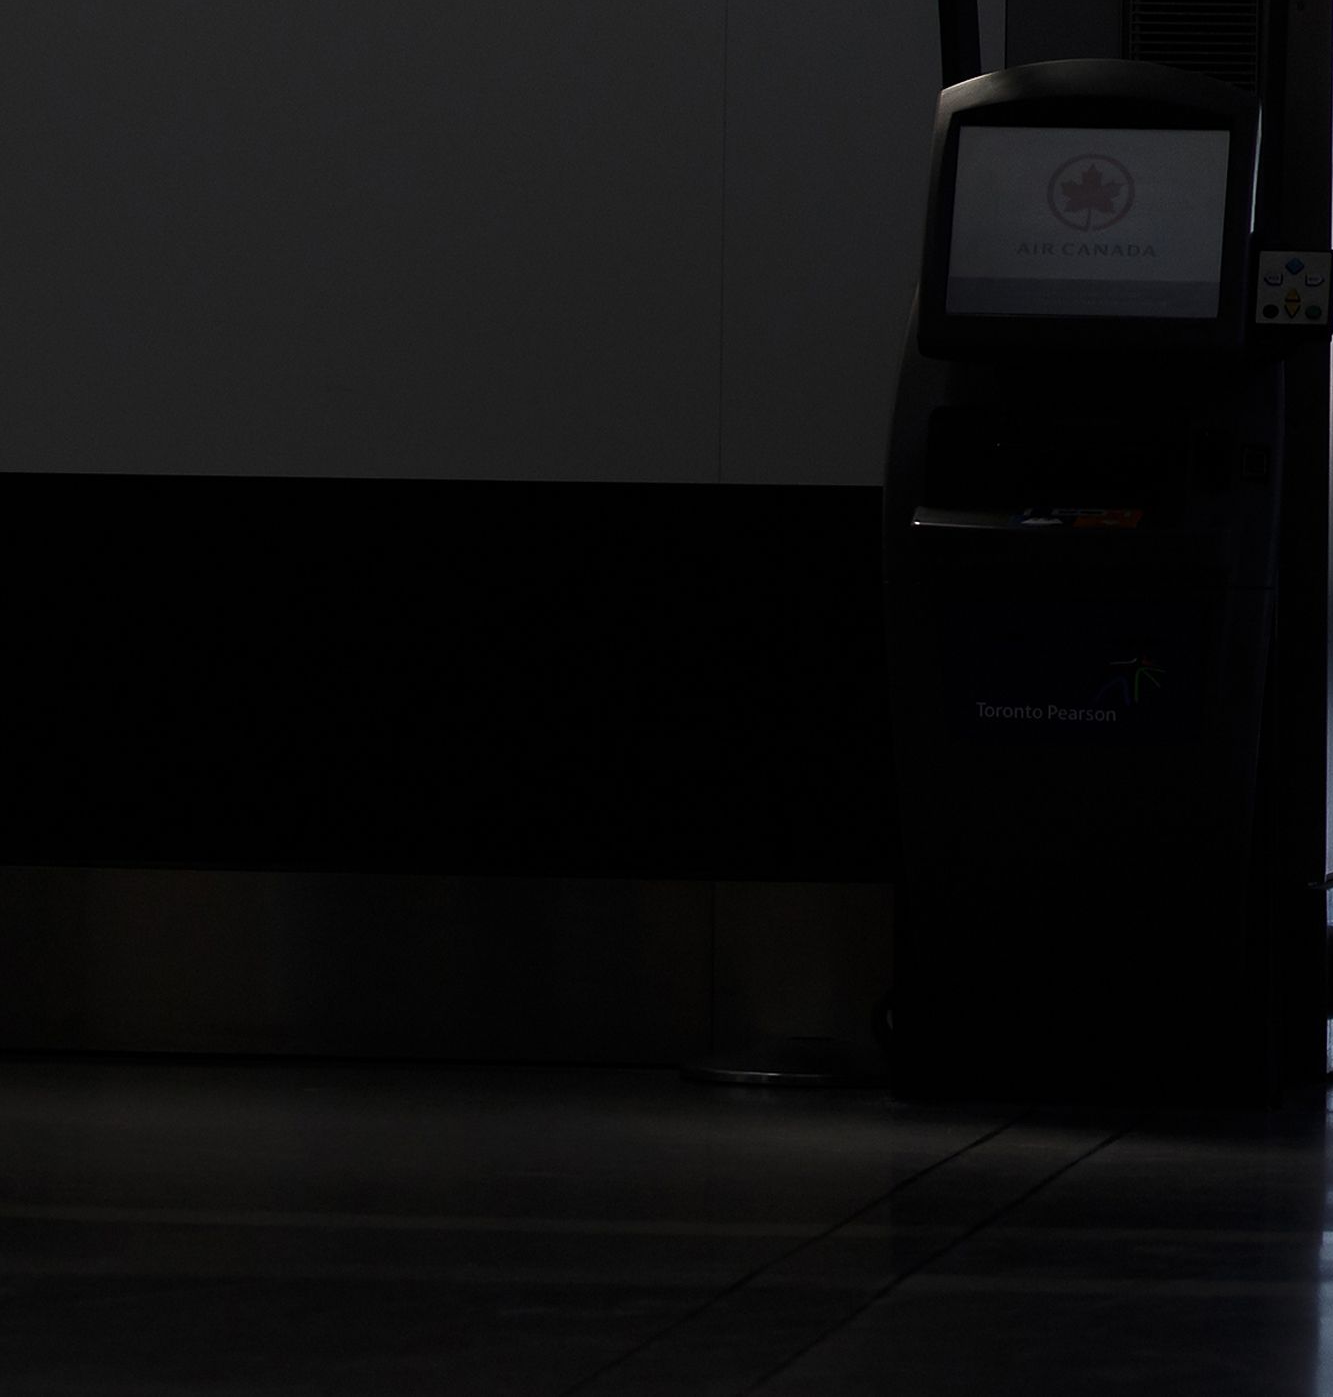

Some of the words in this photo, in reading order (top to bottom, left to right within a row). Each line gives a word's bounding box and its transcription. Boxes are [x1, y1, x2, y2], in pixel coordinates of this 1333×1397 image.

[1017, 242, 1055, 256] AIR
[1063, 242, 1158, 258] CANADA
[975, 701, 1043, 720] Toronto
[1047, 705, 1117, 723] Pearson
